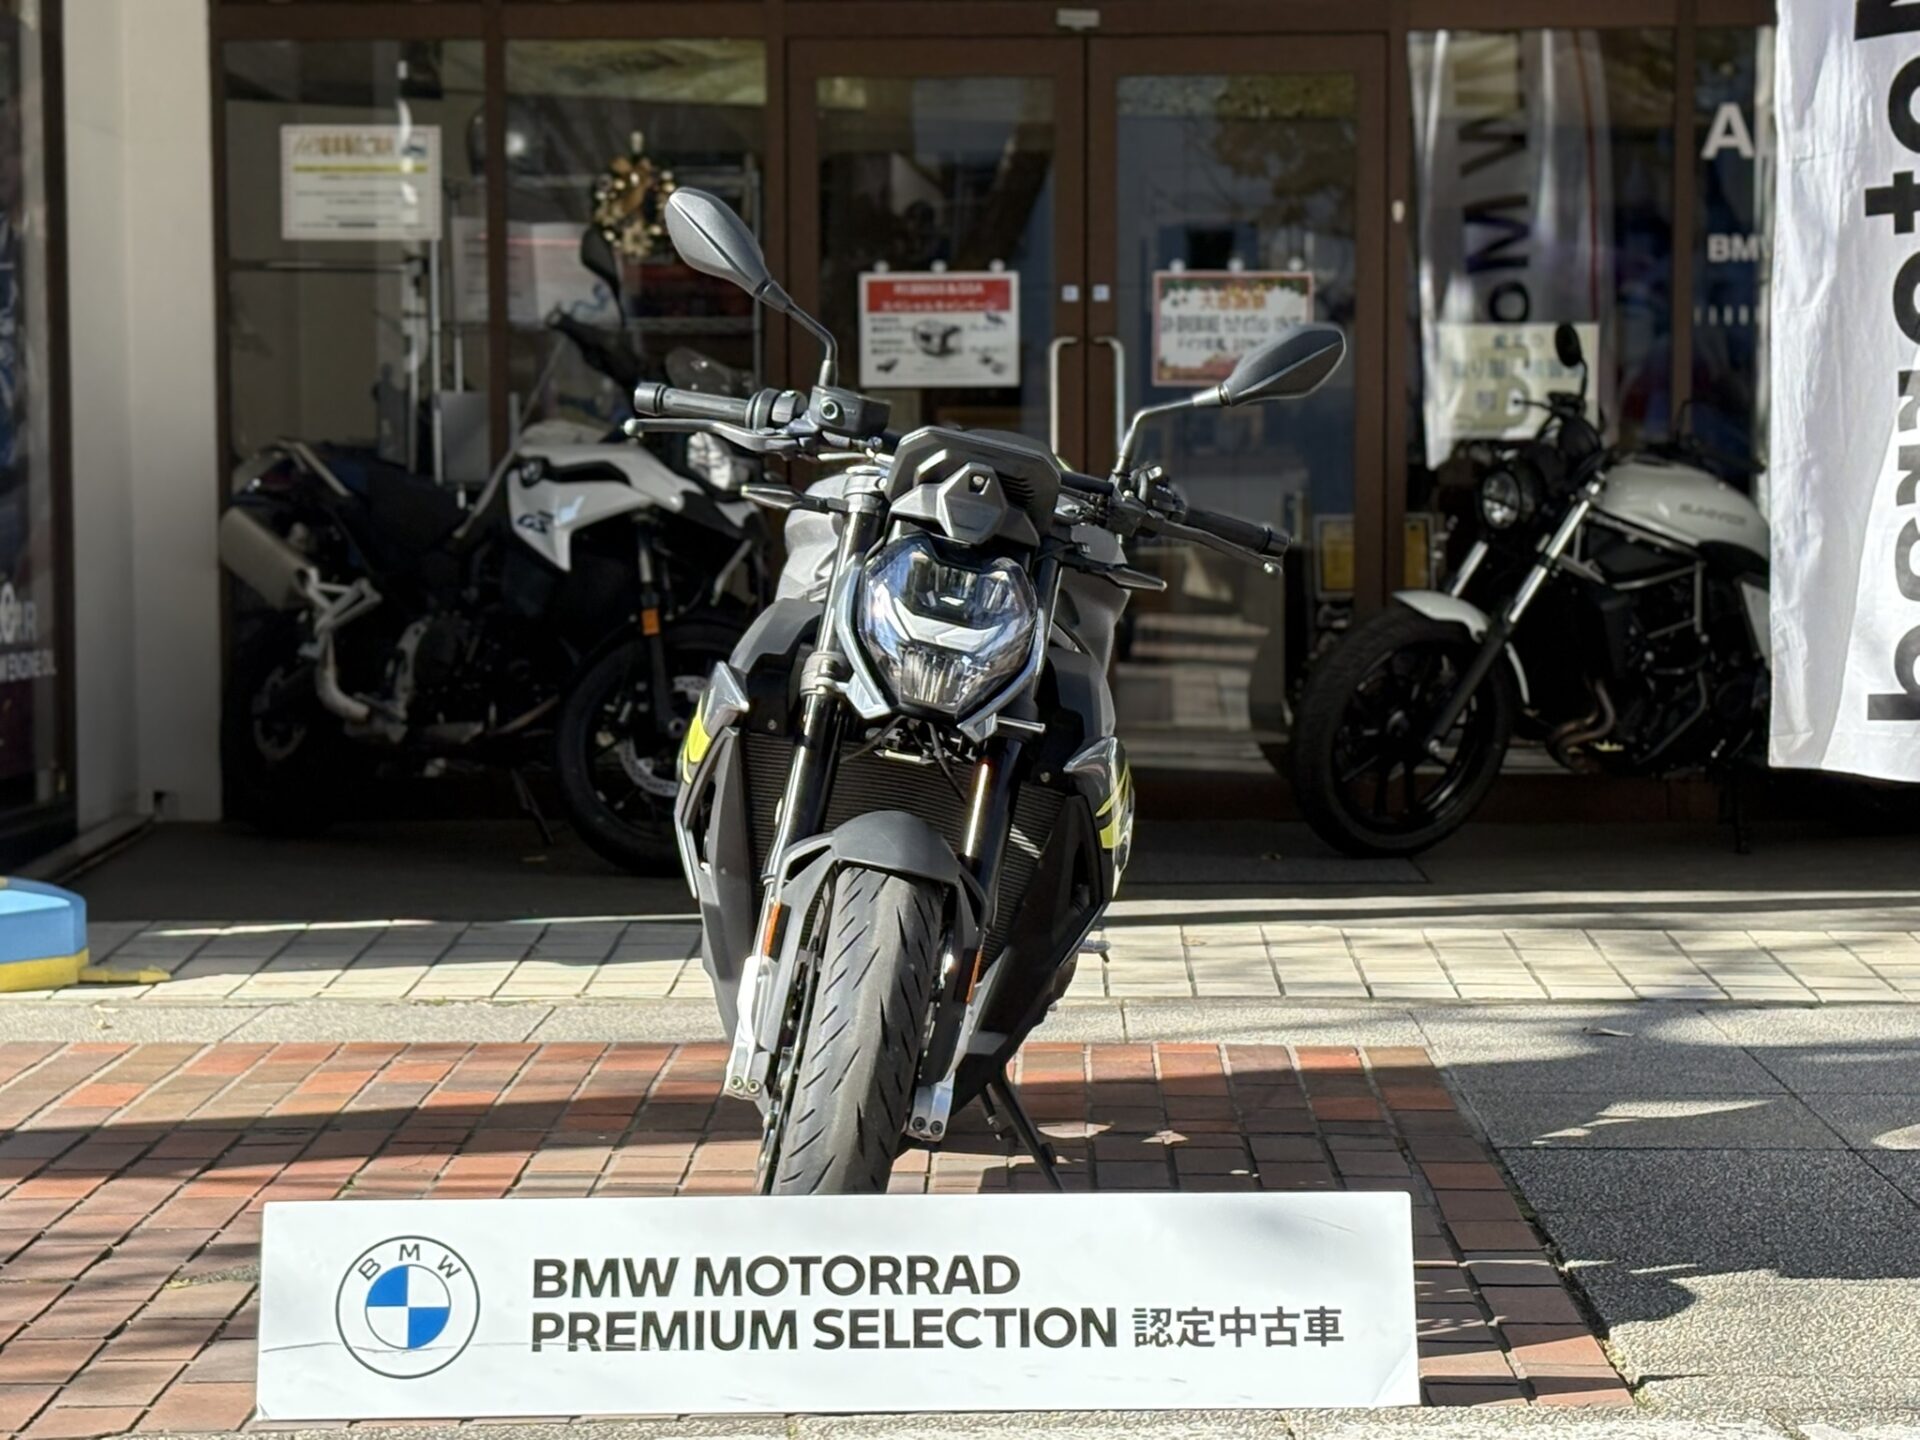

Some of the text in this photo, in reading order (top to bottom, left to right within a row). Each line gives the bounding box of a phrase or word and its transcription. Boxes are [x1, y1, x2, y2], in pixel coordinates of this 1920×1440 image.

[357, 1240, 462, 1281] BMW
[532, 1254, 1020, 1298] BMW MOTORRAD
[531, 1305, 1344, 1353] PREMIUM SELECTION 認定中古車
